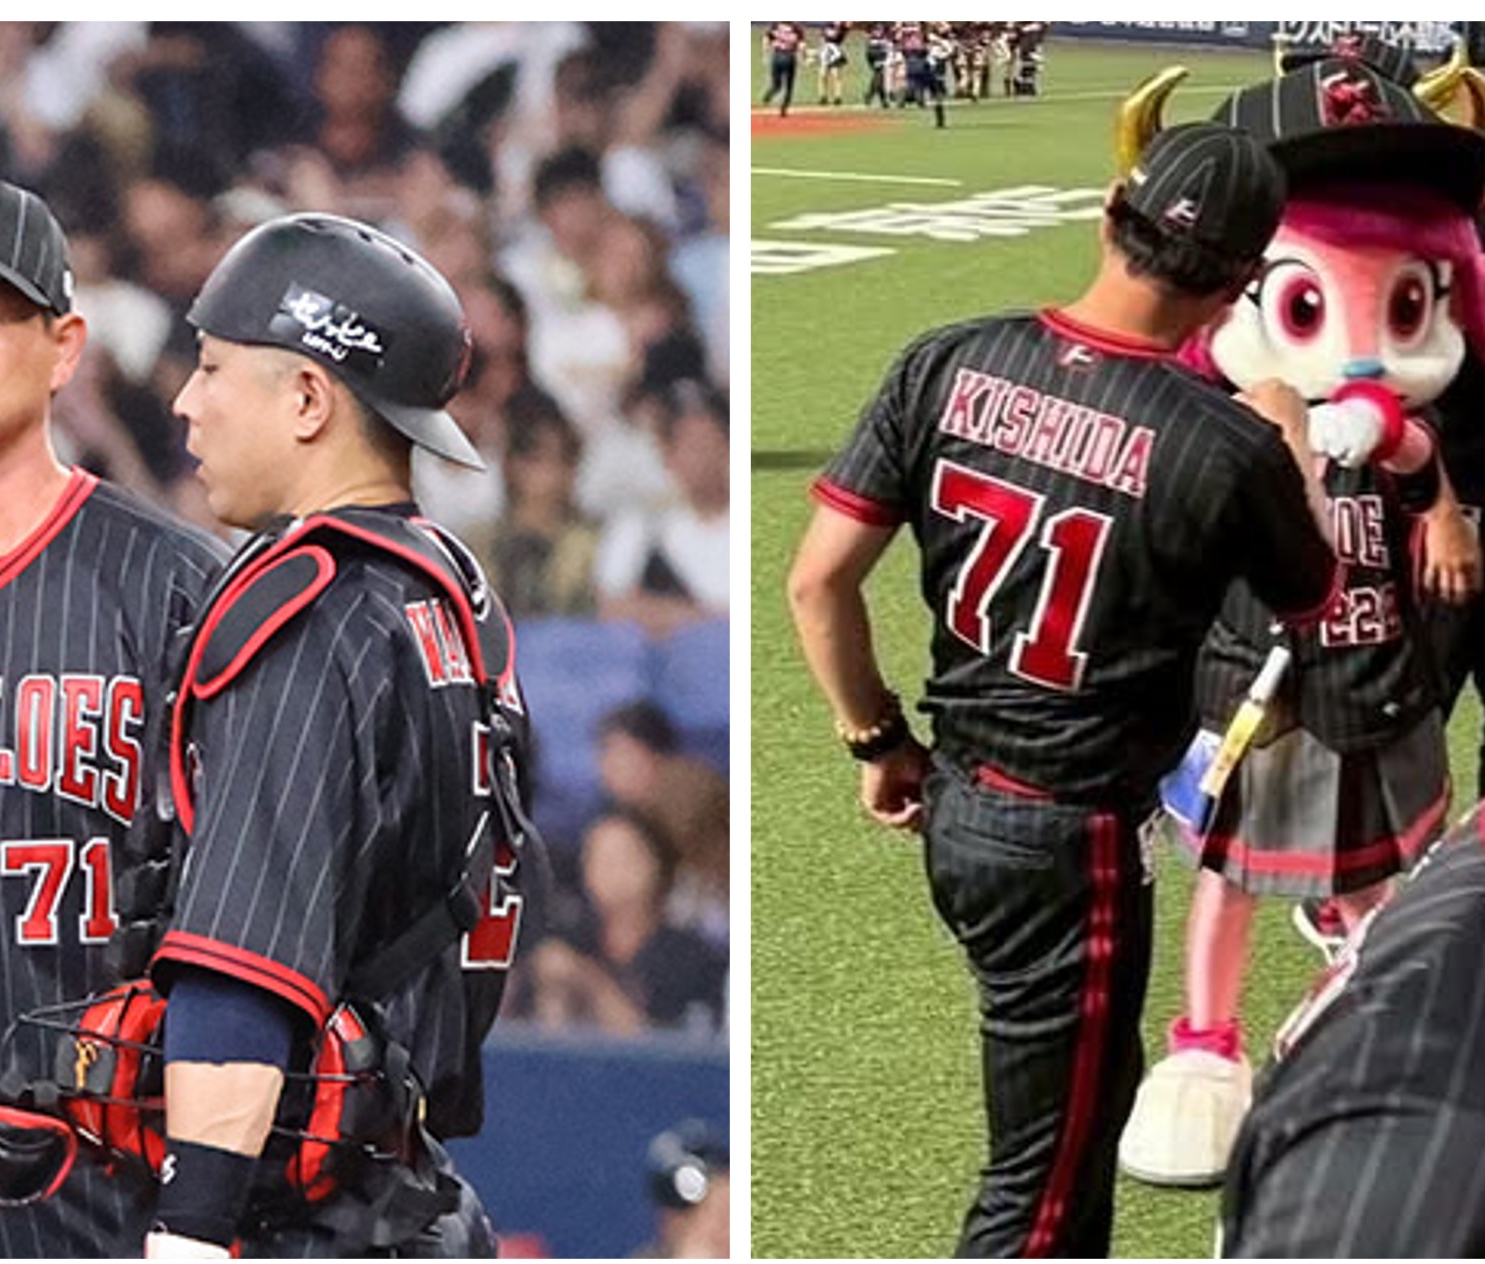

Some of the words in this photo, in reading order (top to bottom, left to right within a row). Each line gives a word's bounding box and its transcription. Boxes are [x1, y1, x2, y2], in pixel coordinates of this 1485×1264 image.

[937, 368, 1158, 499] KISHIDA
[929, 458, 1115, 693] 71
[0, 837, 119, 943] 71
